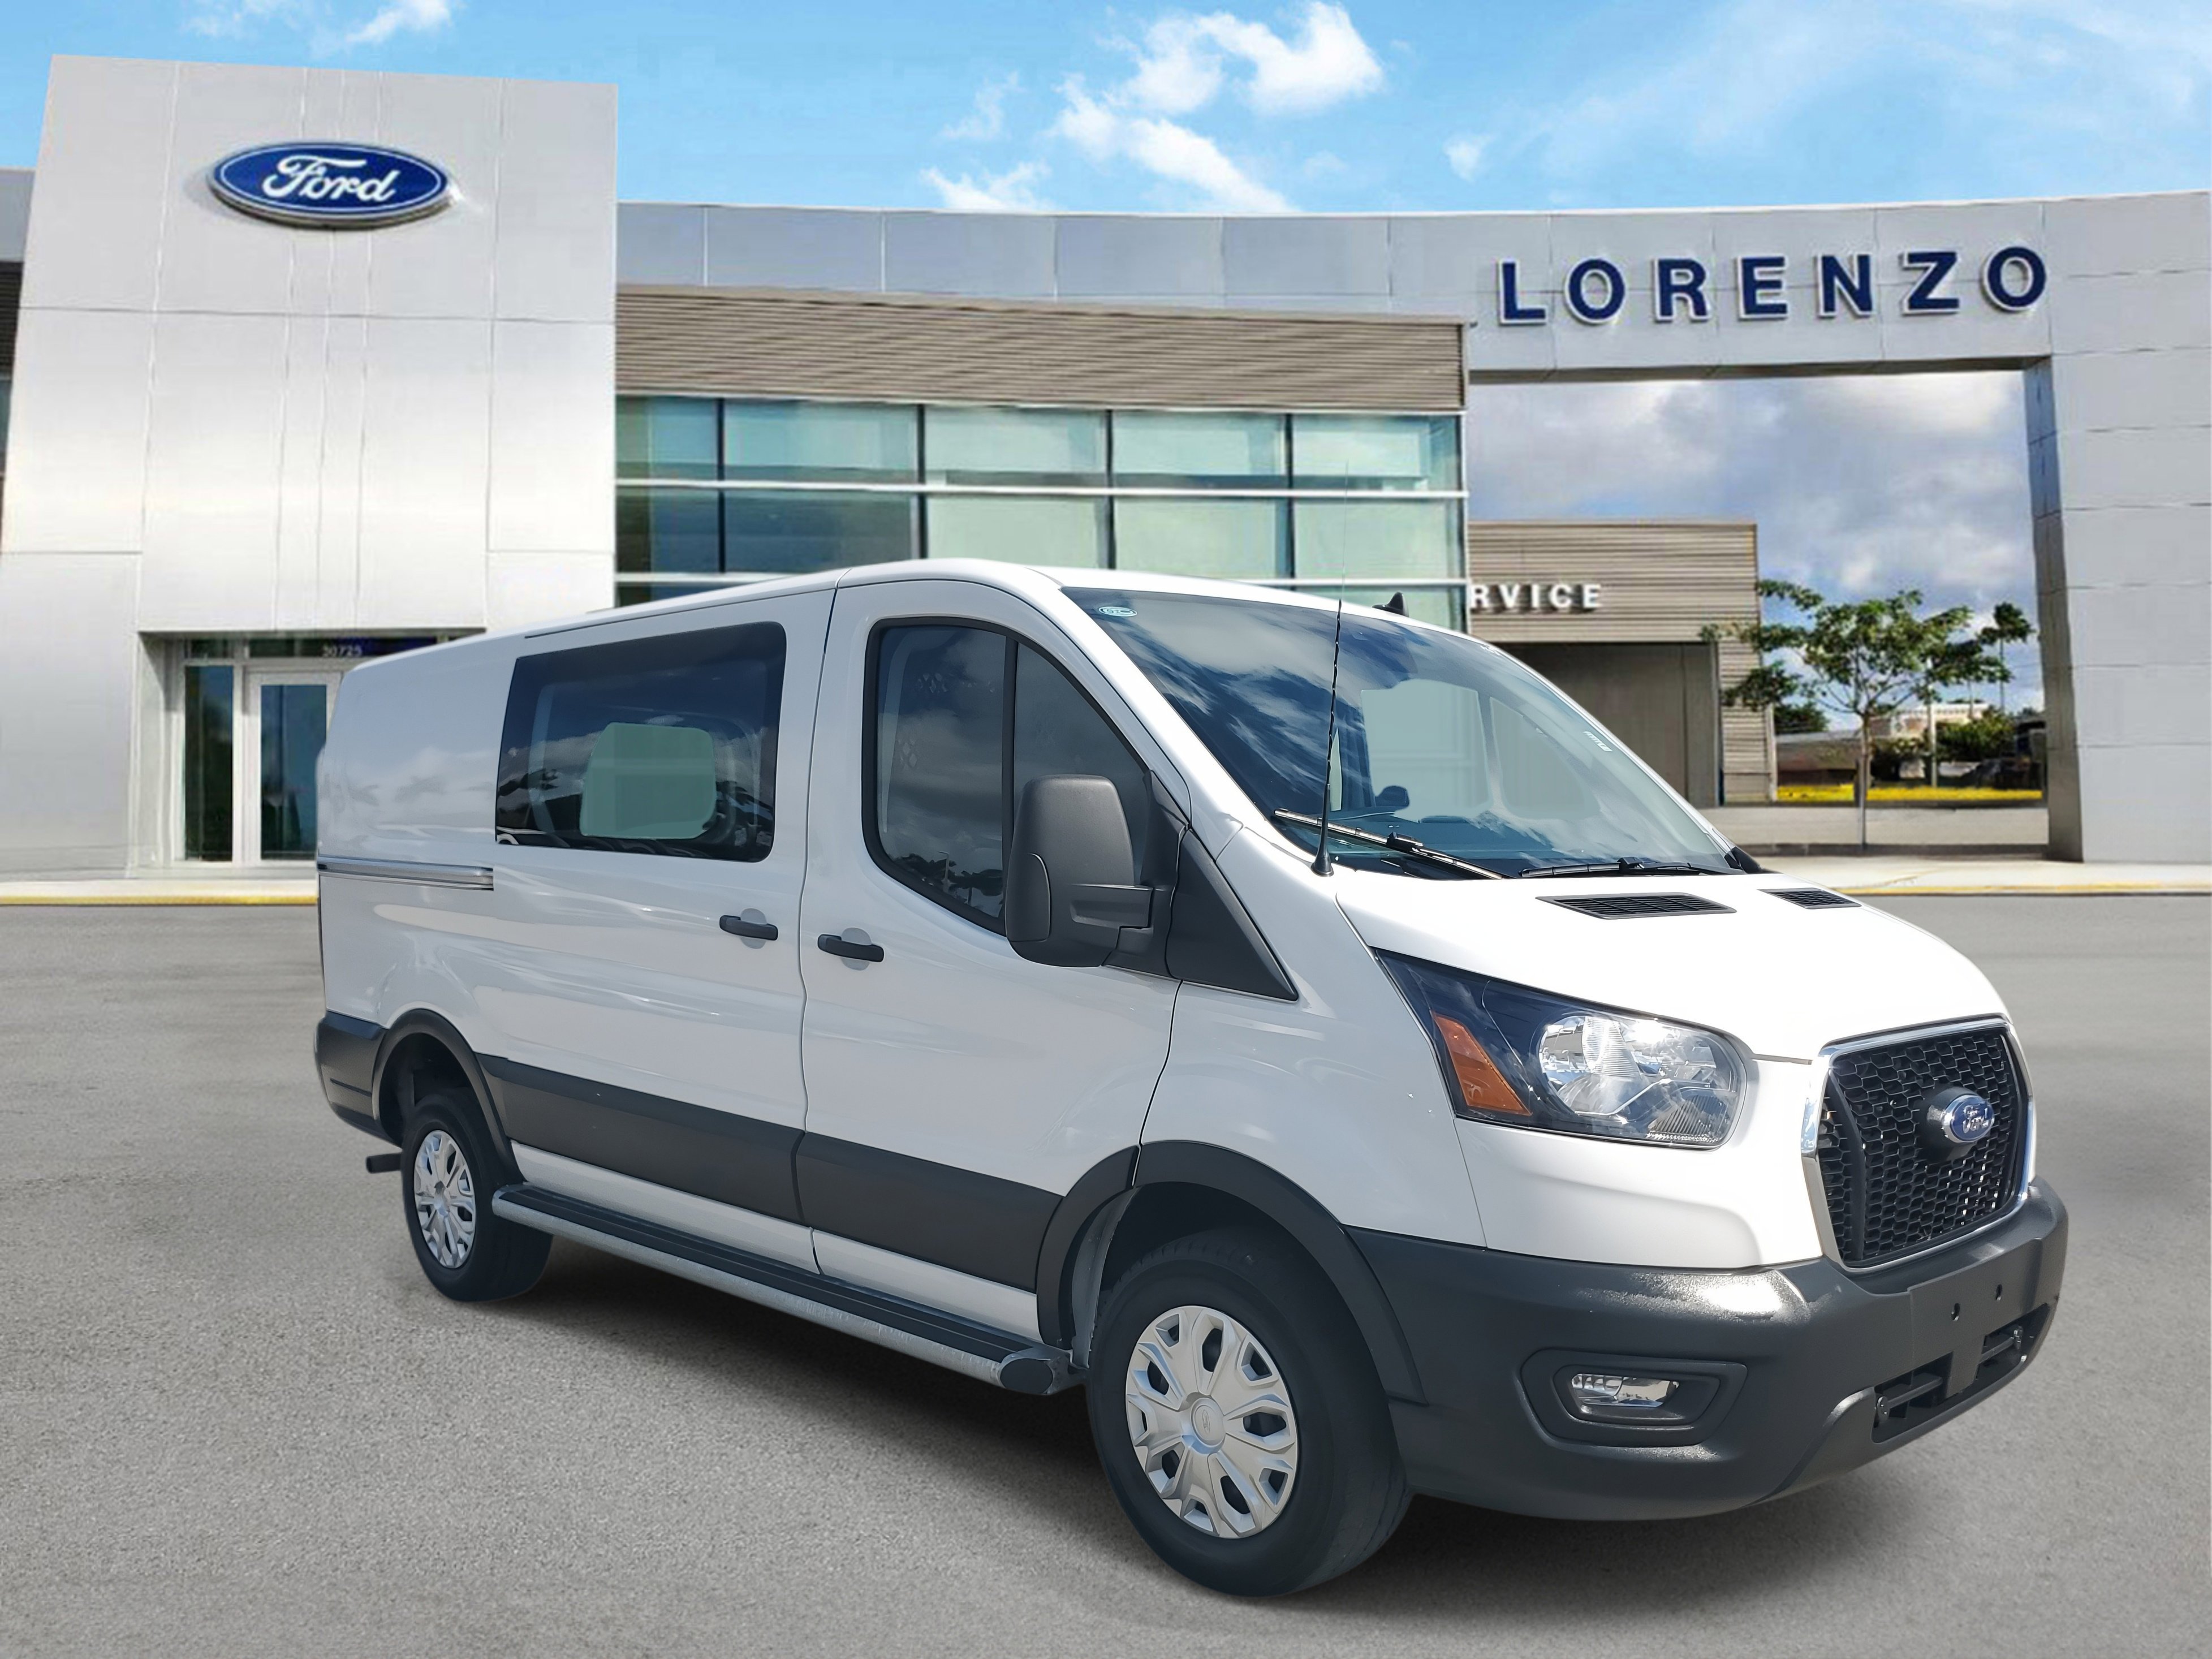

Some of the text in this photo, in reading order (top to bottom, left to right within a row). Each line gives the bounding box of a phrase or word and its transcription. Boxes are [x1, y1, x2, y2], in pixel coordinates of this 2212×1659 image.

[262, 154, 400, 201] Ford
[1498, 245, 2047, 326] LORENZO
[1963, 1104, 1989, 1133] Ford
